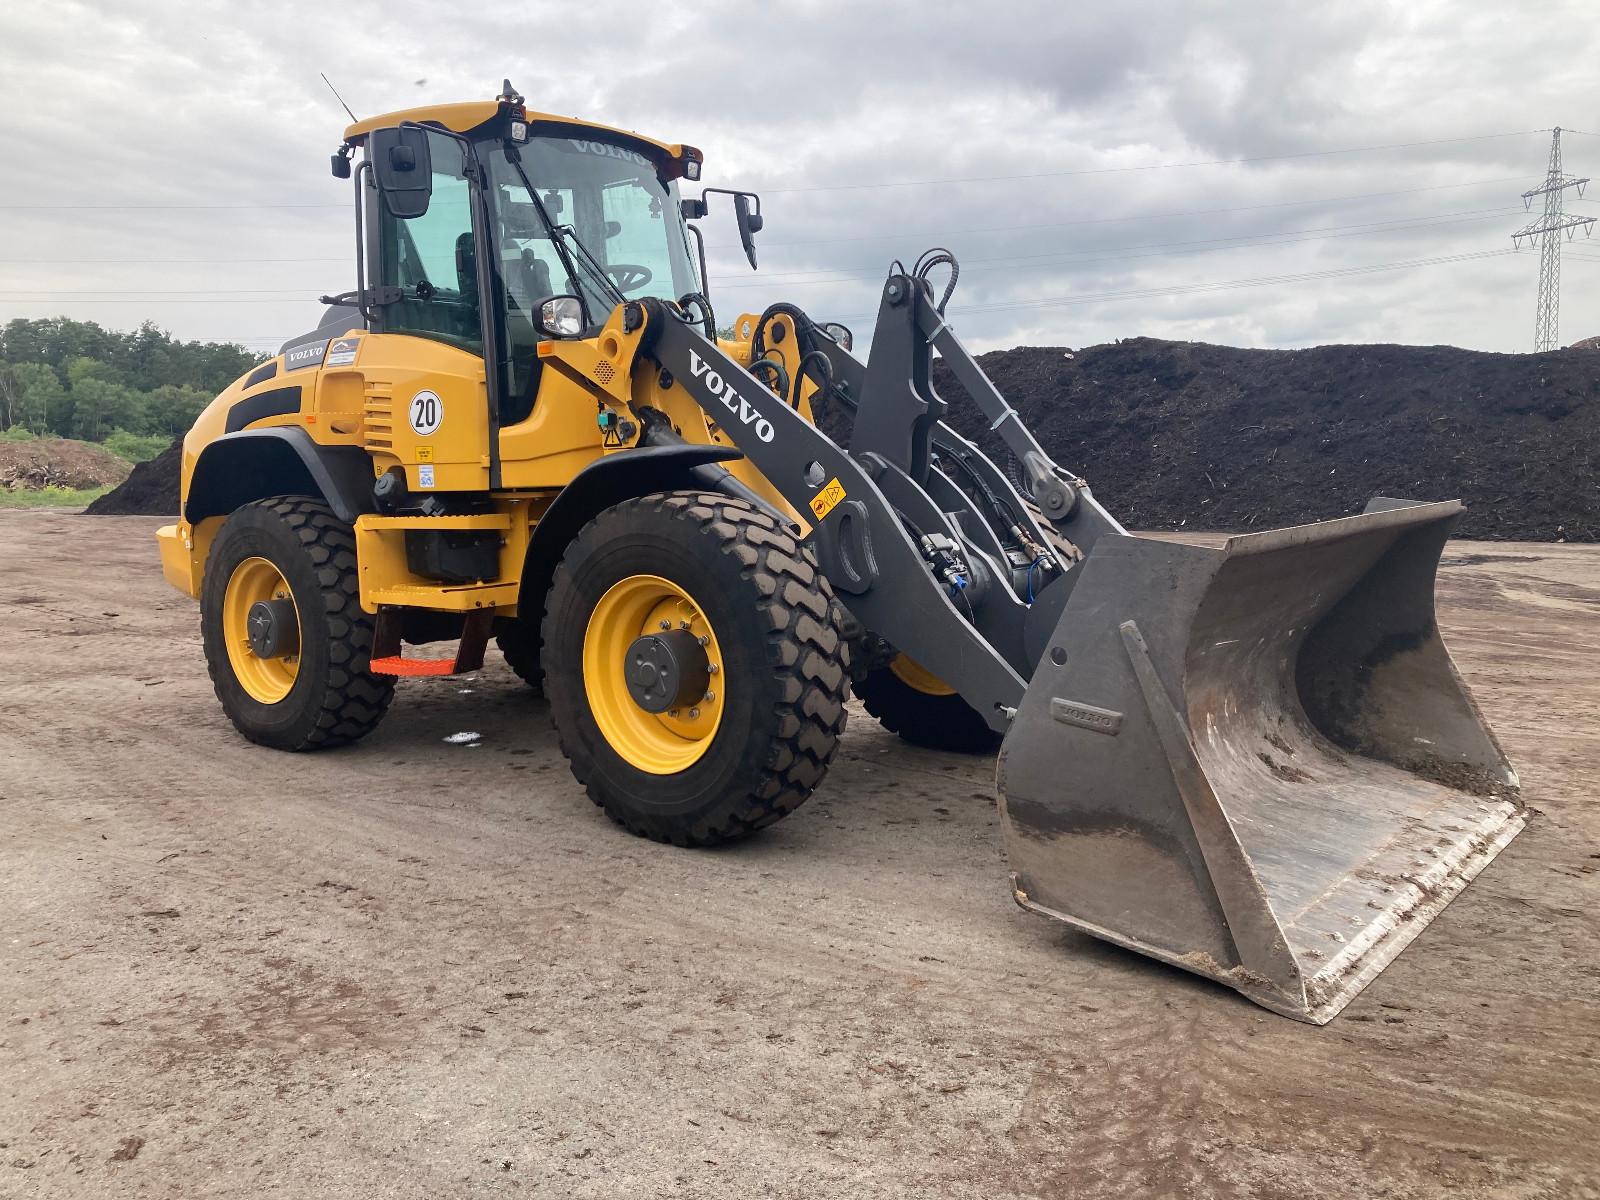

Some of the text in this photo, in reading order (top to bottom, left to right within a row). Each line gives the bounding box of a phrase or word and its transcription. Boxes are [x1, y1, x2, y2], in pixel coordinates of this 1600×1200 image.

[568, 139, 647, 166] VOLVO
[290, 347, 323, 362] VOLVO
[688, 348, 775, 443] VOLVO
[415, 398, 435, 428] 20
